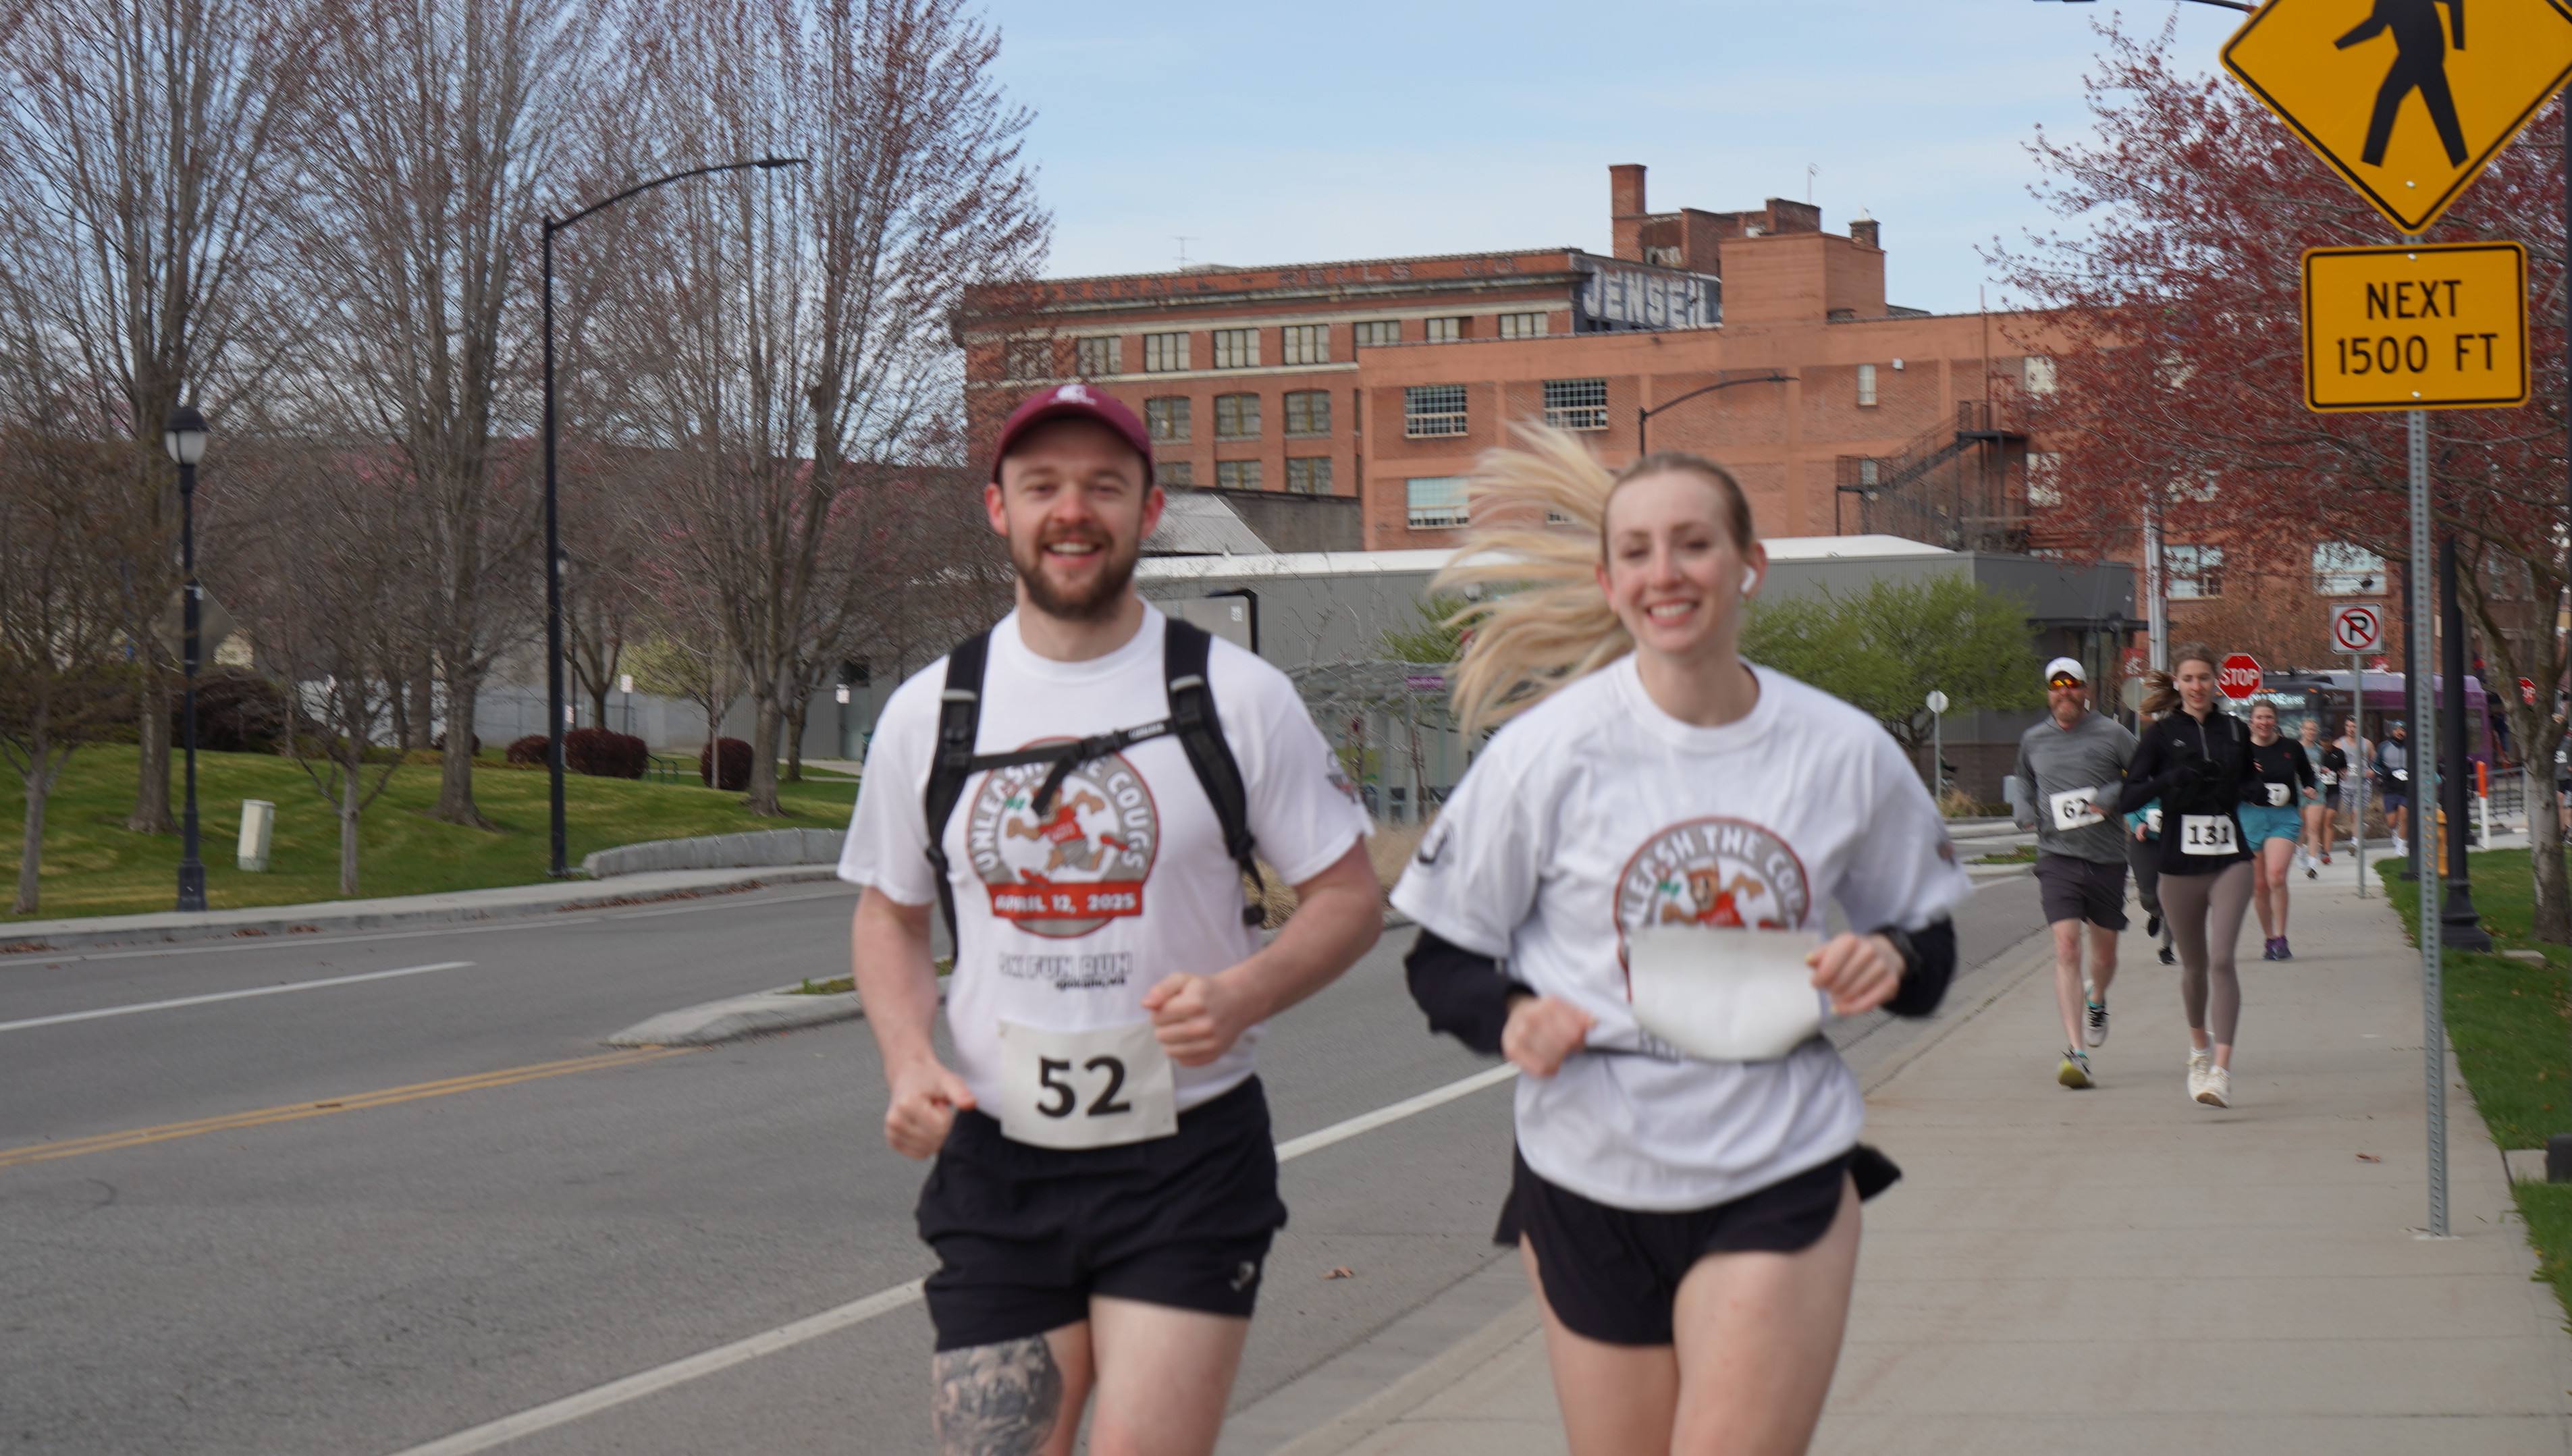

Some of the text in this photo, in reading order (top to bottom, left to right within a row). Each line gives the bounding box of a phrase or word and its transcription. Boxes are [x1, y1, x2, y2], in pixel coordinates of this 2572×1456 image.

[2367, 279, 2462, 320] NEXT
[2336, 333, 2498, 375] 1500 FT
[2219, 667, 2259, 686] STOP
[1106, 772, 1148, 869] COUGS
[2063, 799, 2091, 819] 62
[1701, 825, 1761, 859] THE
[2188, 824, 2230, 845] 131
[994, 894, 1046, 911] APRIL
[1087, 892, 1136, 911] 2025
[1036, 1055, 1131, 1118] 52
